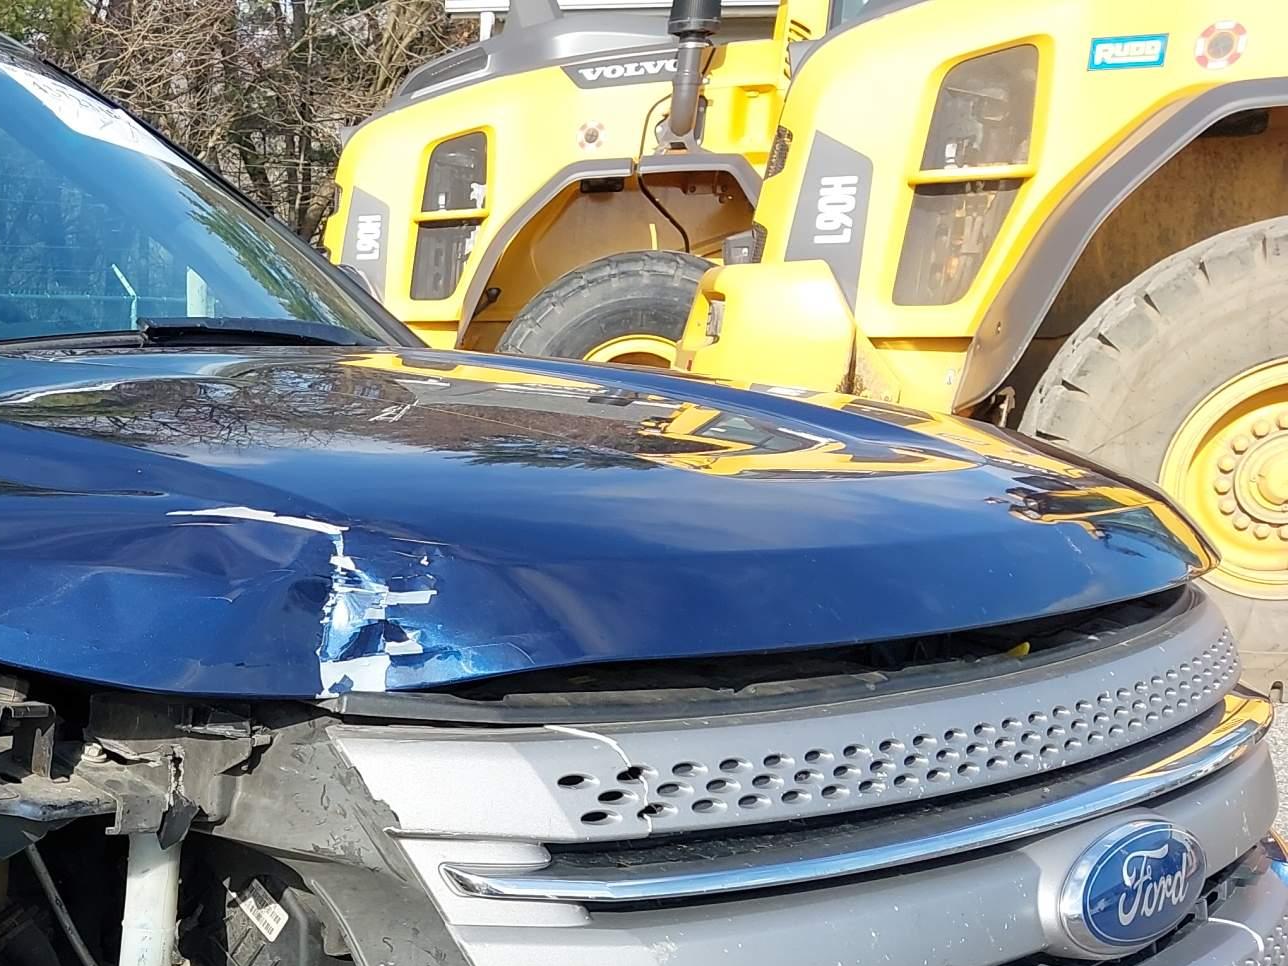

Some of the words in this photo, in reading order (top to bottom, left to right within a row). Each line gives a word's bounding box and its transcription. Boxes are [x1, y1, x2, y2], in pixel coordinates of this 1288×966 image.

[356, 214, 381, 260] L90H
[813, 175, 859, 244] L90H
[1118, 844, 1189, 926] Ford
